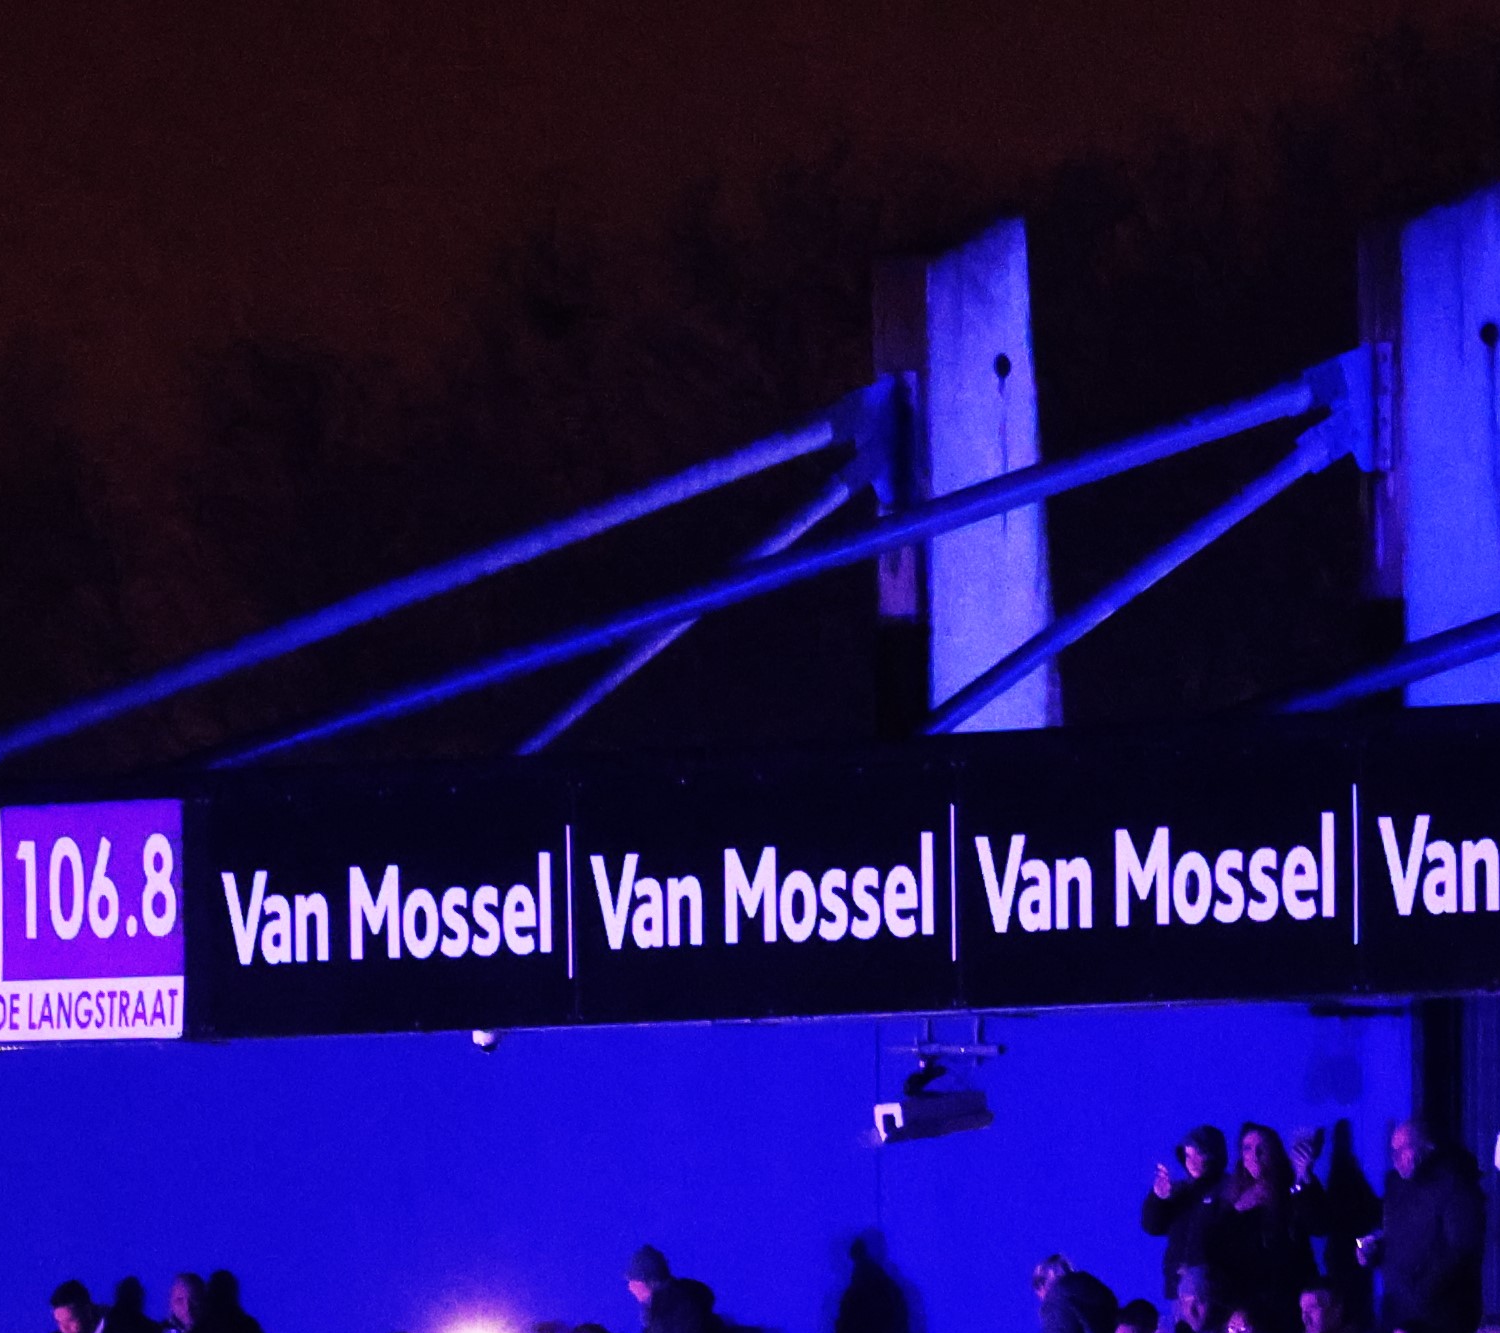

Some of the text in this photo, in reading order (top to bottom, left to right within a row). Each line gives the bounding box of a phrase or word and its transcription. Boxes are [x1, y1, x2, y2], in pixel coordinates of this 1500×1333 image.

[15, 833, 177, 940] 106.8
[221, 851, 552, 965] Van Mossel
[590, 831, 934, 951] Van Mossel
[975, 811, 1335, 934] Van Mossel
[1378, 814, 1500, 917] Van
[27, 988, 178, 1030] LANGSTRAAT
